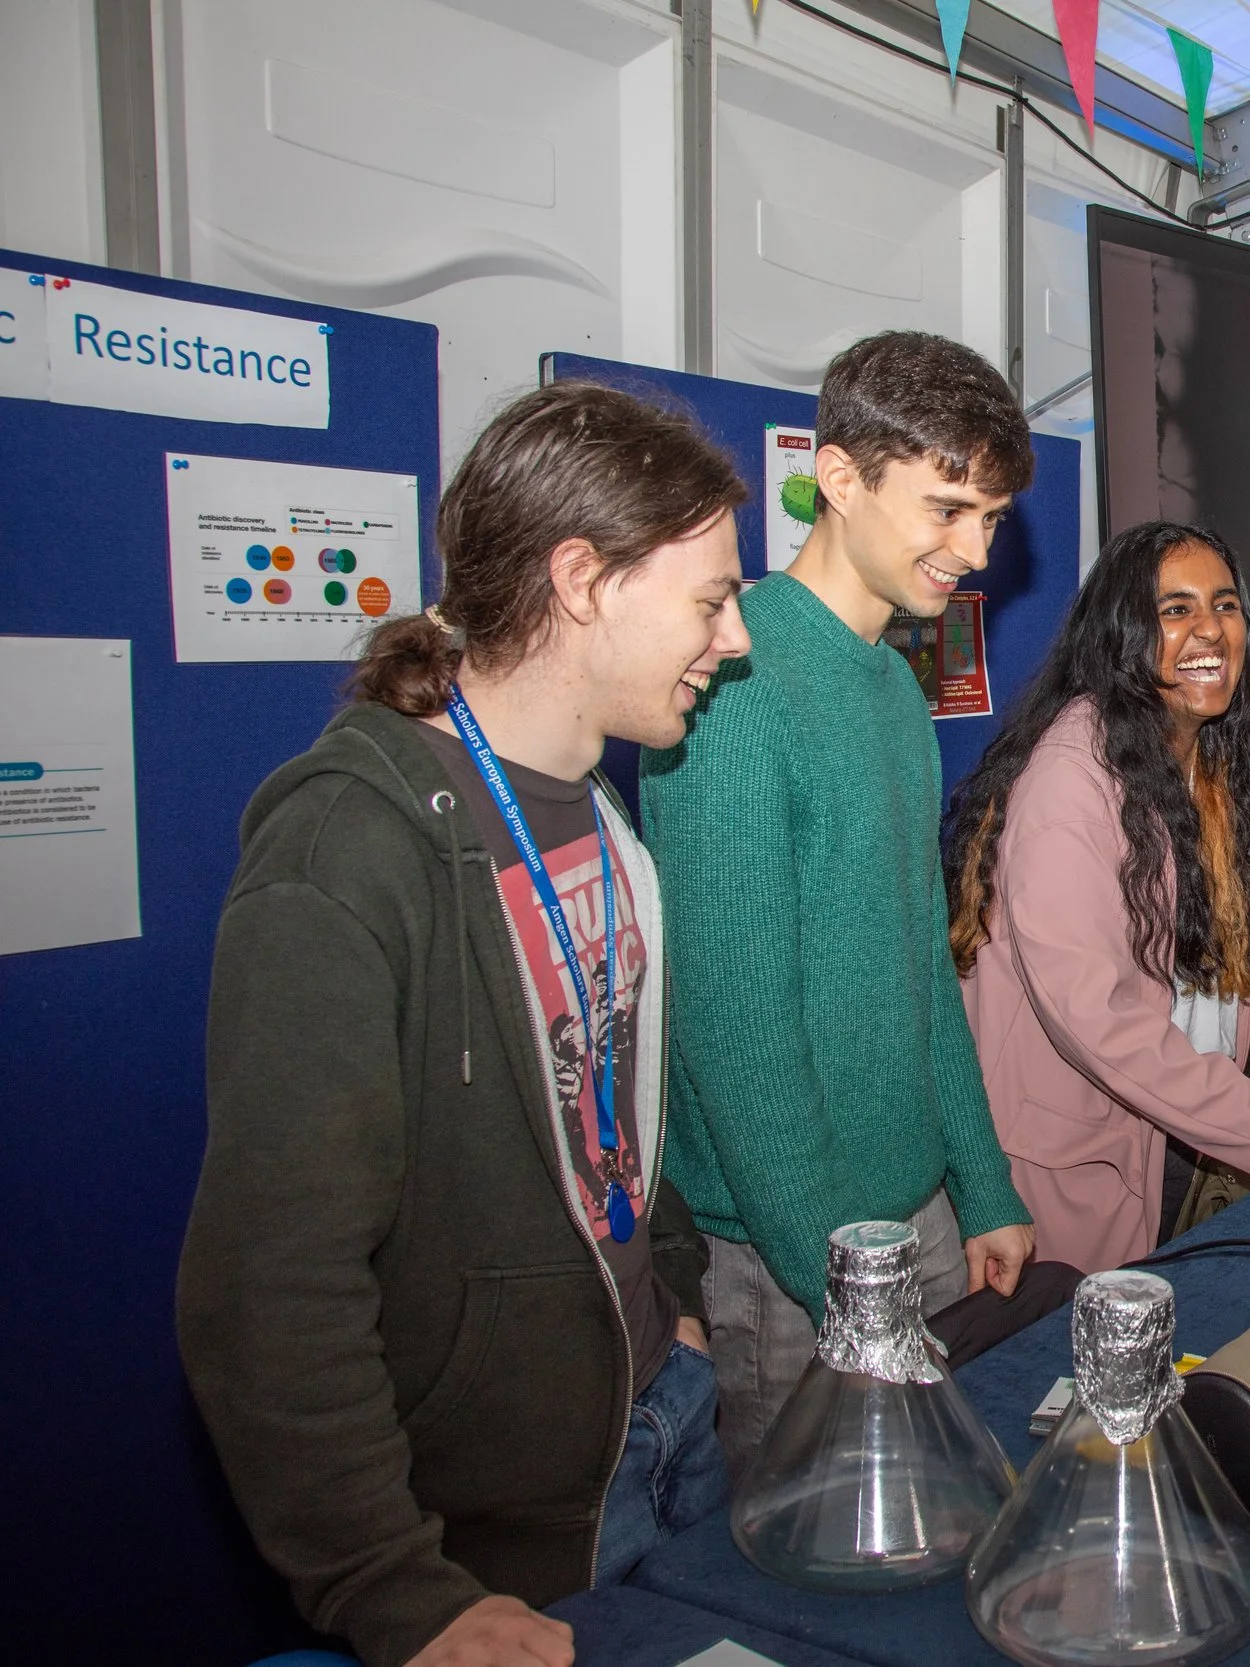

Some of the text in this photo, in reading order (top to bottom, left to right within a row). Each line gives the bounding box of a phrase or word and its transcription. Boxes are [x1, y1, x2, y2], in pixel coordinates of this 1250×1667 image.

[75, 313, 311, 388] Resistance
[799, 440, 809, 448] cell
[198, 514, 265, 525] Antibiotic discovery
[453, 702, 541, 873] Scholars European Symposium
[539, 873, 634, 966] RUN
[550, 905, 570, 945] Amgen
[565, 944, 585, 993] Scholars
